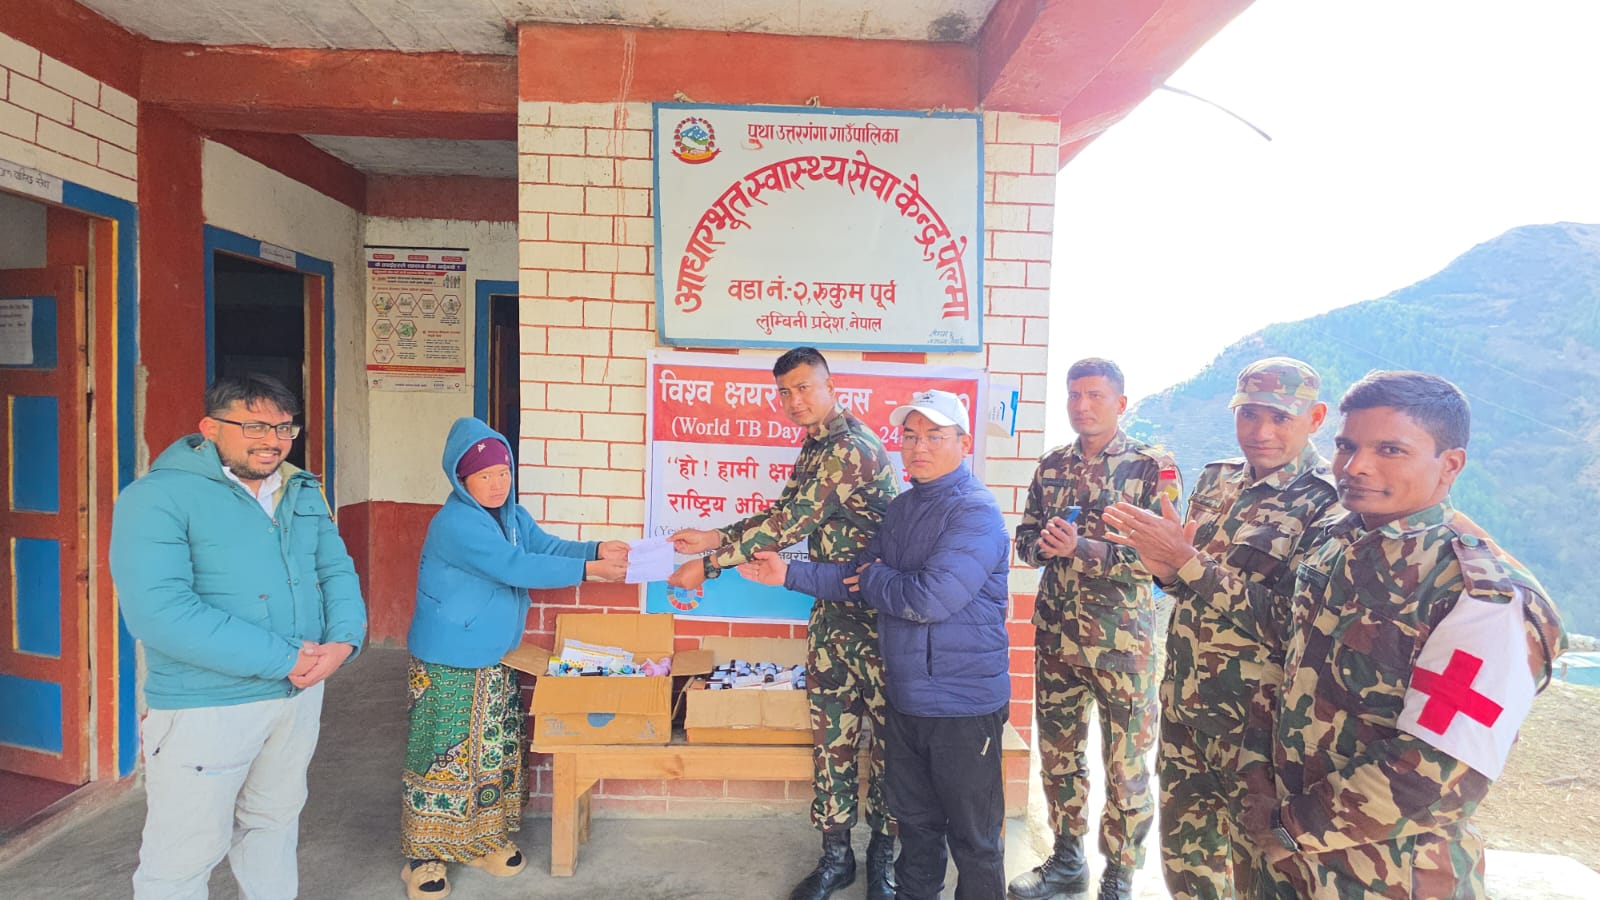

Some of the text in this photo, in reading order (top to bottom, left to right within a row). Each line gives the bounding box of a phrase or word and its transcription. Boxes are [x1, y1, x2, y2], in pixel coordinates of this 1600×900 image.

[743, 155, 849, 206] स्वास्थ्य
[847, 150, 902, 203] सेवा
[728, 280, 764, 302] वडा
[869, 280, 897, 310] पूर्व
[849, 311, 882, 333] नेपाल
[659, 369, 714, 406] विश्व
[671, 416, 731, 438] (World
[736, 419, 763, 438] TB
[767, 420, 802, 444] Day
[717, 456, 760, 482] हामी
